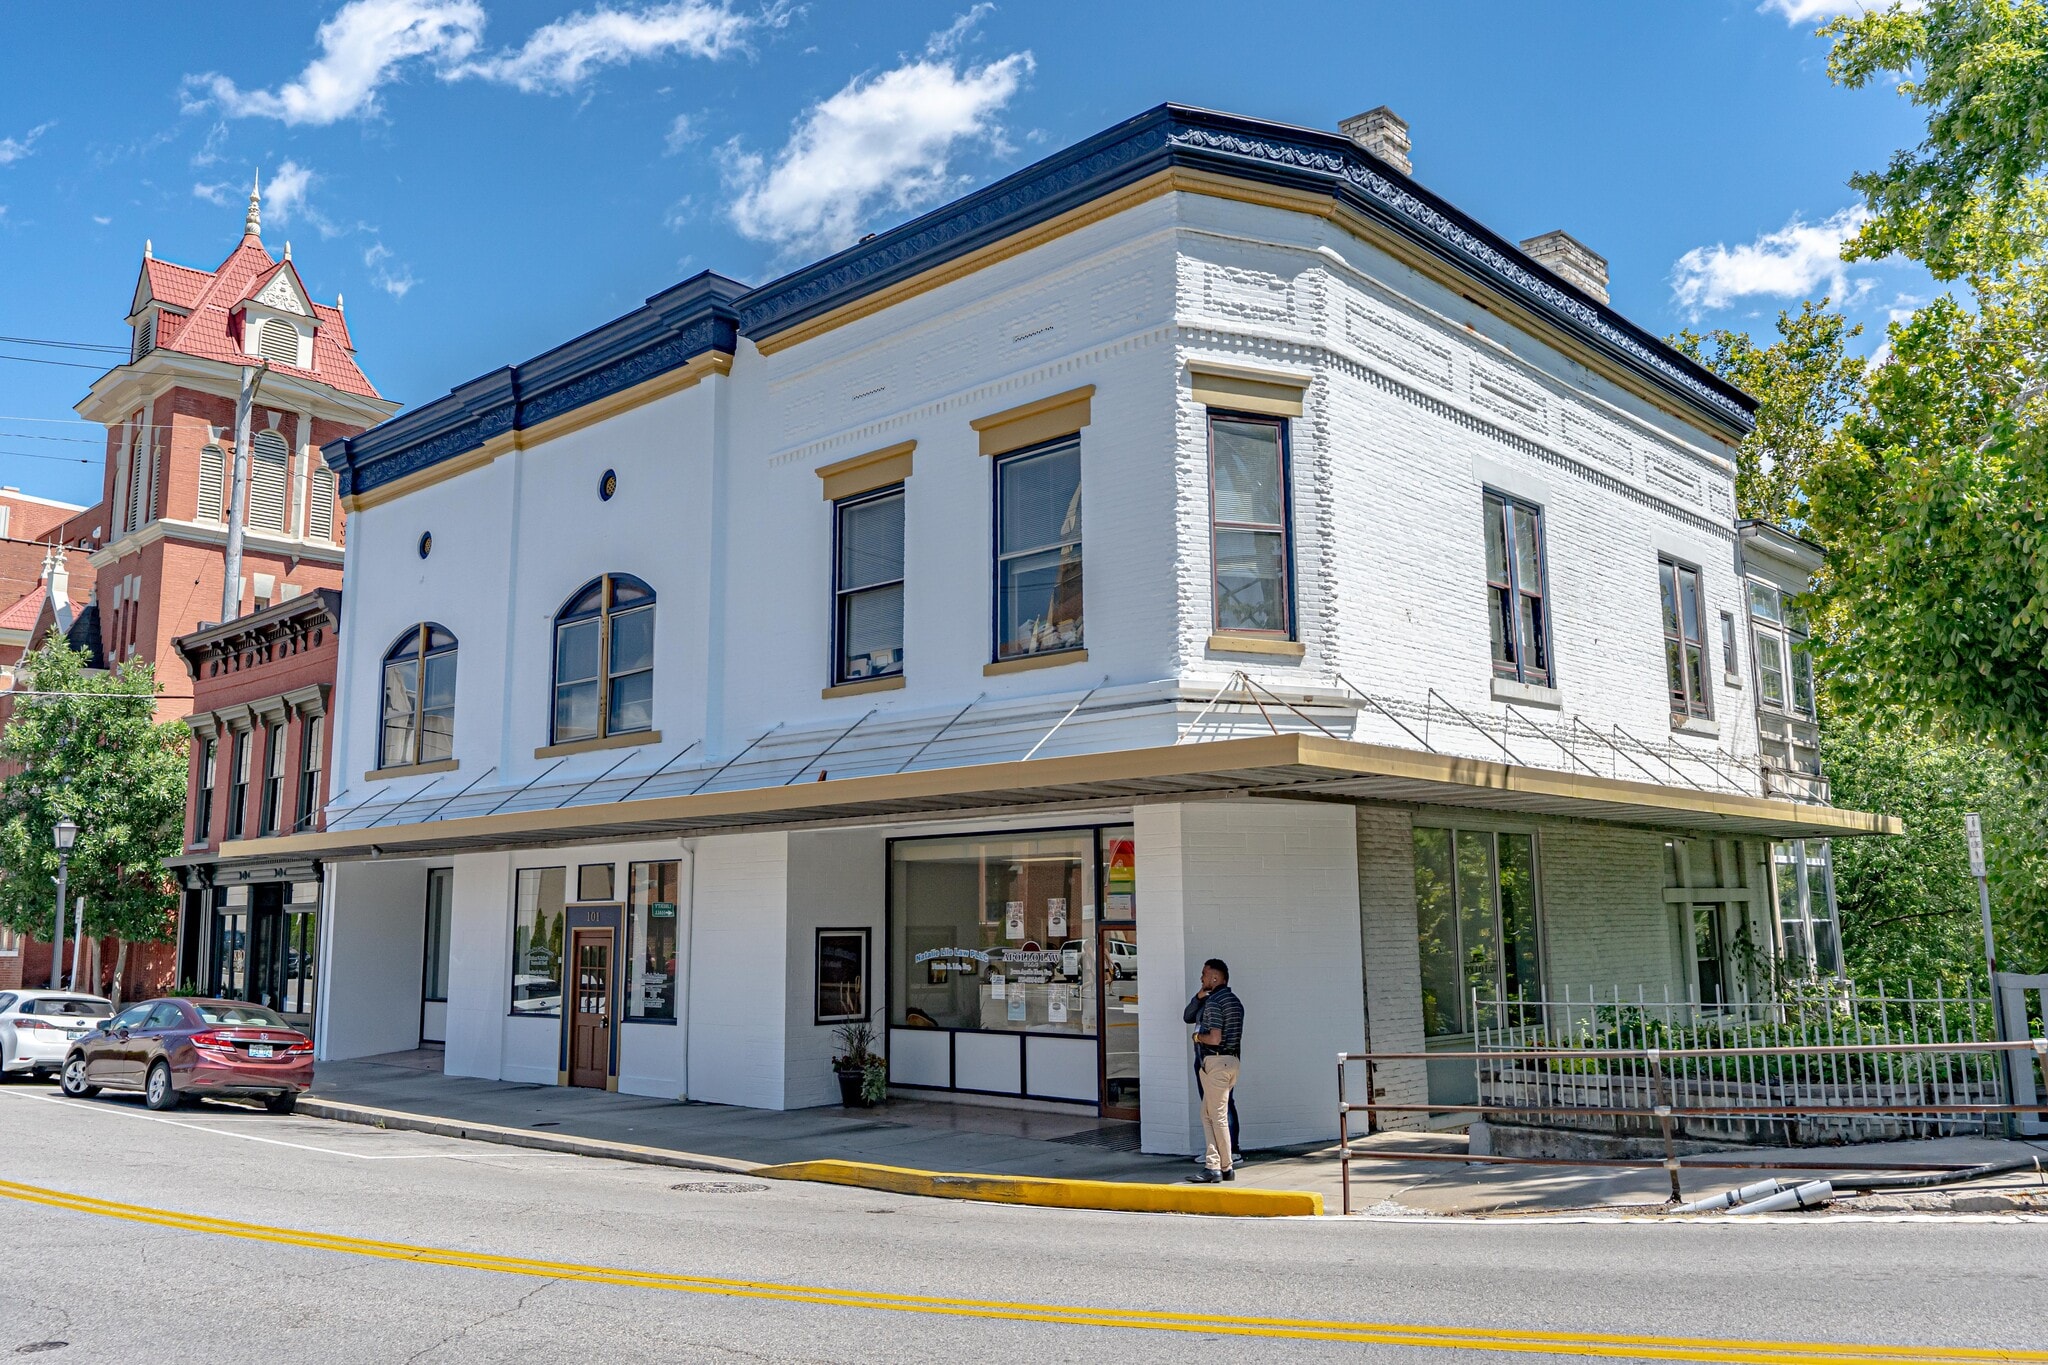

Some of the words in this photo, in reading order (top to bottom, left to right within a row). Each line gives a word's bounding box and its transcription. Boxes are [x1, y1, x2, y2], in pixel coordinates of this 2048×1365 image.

[587, 911, 600, 922] 101
[915, 948, 940, 964] Natalie
[940, 947, 954, 957] Lile
[954, 946, 969, 958] Law
[970, 949, 990, 963] PLLC
[1002, 952, 1040, 963] APOLLO
[1040, 952, 1060, 963] LAW
